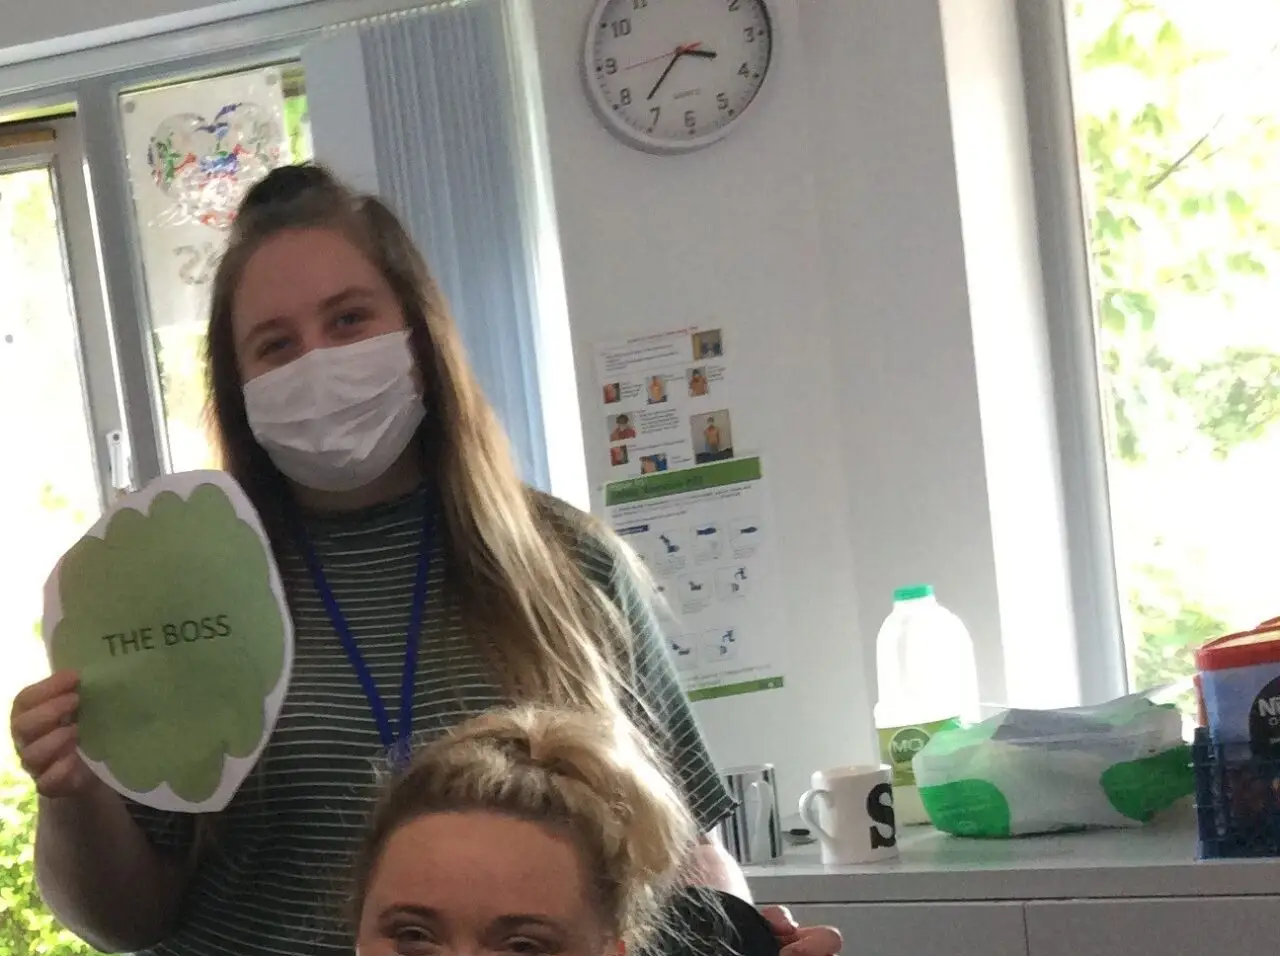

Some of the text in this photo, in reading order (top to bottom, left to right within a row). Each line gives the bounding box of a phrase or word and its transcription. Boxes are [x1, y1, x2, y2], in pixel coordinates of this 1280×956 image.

[611, 17, 632, 39] 10
[743, 26, 754, 43] 3
[604, 57, 618, 75] 9
[737, 61, 749, 79] 4
[620, 87, 632, 107] 8
[716, 92, 729, 111] 5
[649, 106, 660, 128] 7
[684, 110, 696, 128] 6
[102, 614, 232, 657] THE BOSS
[866, 782, 897, 848] S
